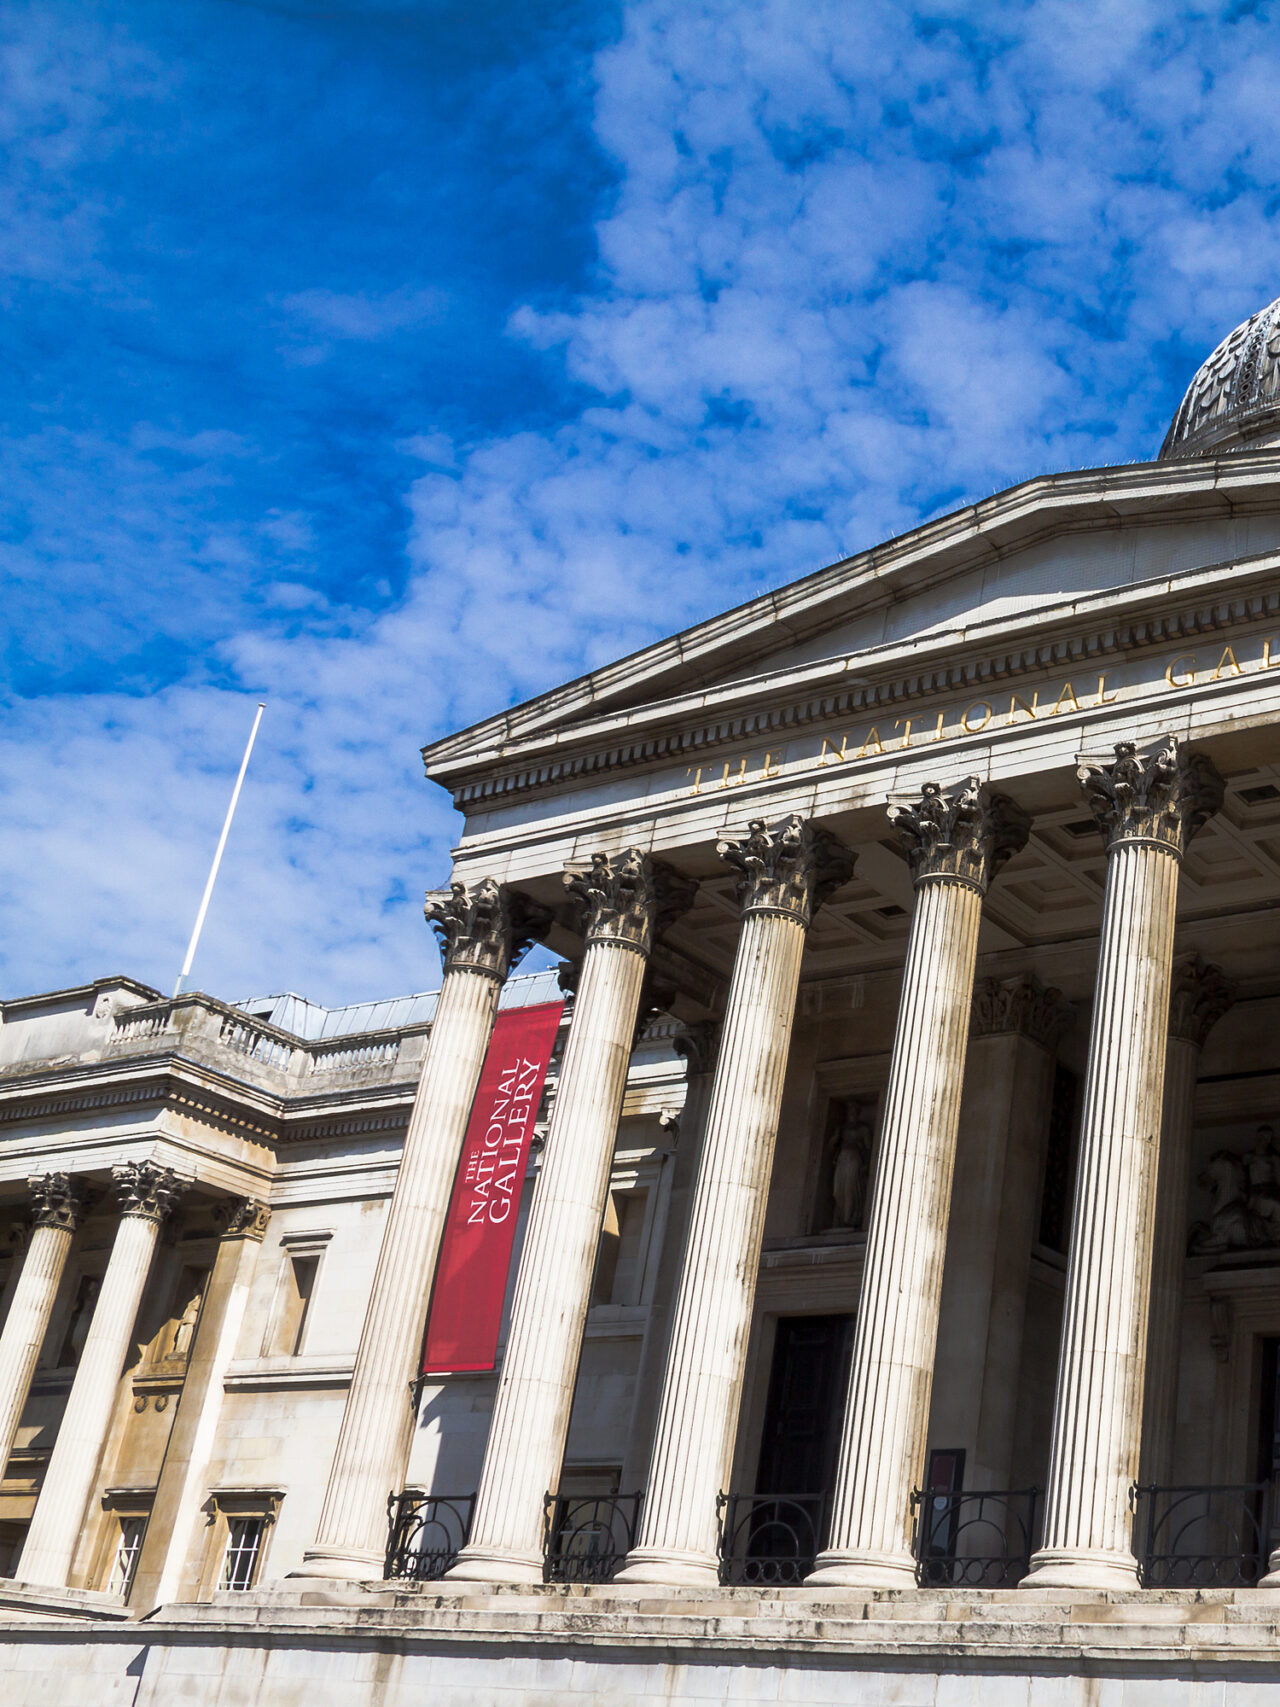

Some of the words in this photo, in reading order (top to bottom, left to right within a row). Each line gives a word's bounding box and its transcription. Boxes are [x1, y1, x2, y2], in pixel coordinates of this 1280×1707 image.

[687, 748, 783, 795] THE
[818, 671, 1119, 767] NATIONAL
[465, 1150, 480, 1184] THE
[467, 1058, 521, 1225] NATIONAL
[488, 1057, 541, 1224] GALLERY
